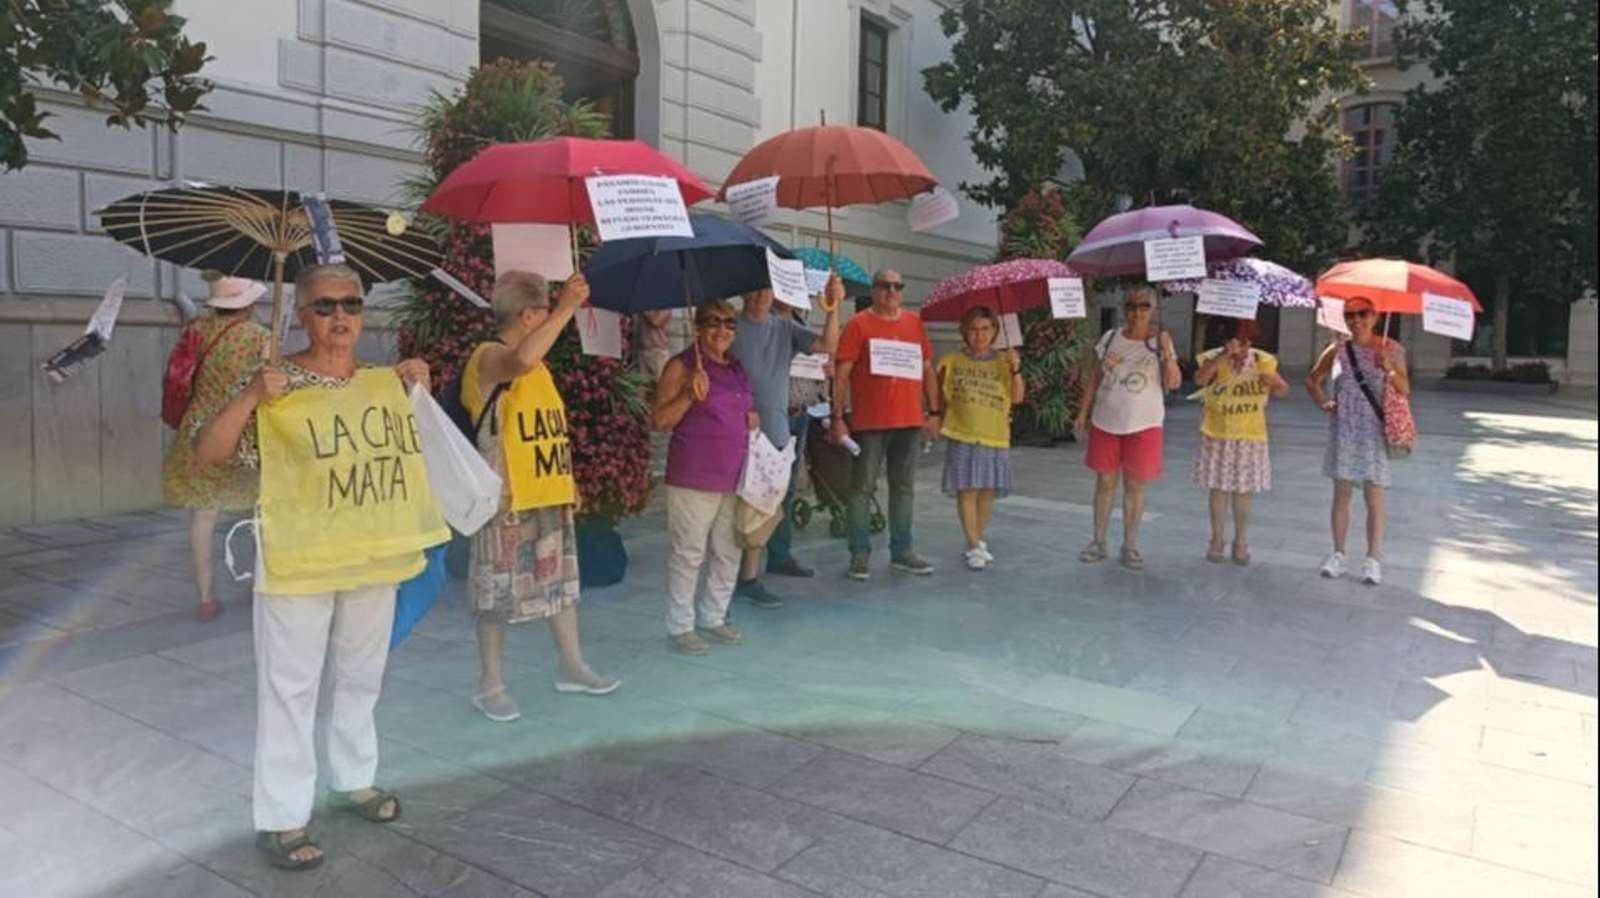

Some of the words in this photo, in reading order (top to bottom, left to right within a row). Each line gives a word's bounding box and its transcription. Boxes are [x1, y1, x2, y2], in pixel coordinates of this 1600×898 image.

[307, 413, 359, 460] LA
[360, 405, 423, 455] CALLE
[517, 408, 548, 443] LA
[328, 455, 408, 509] MATA
